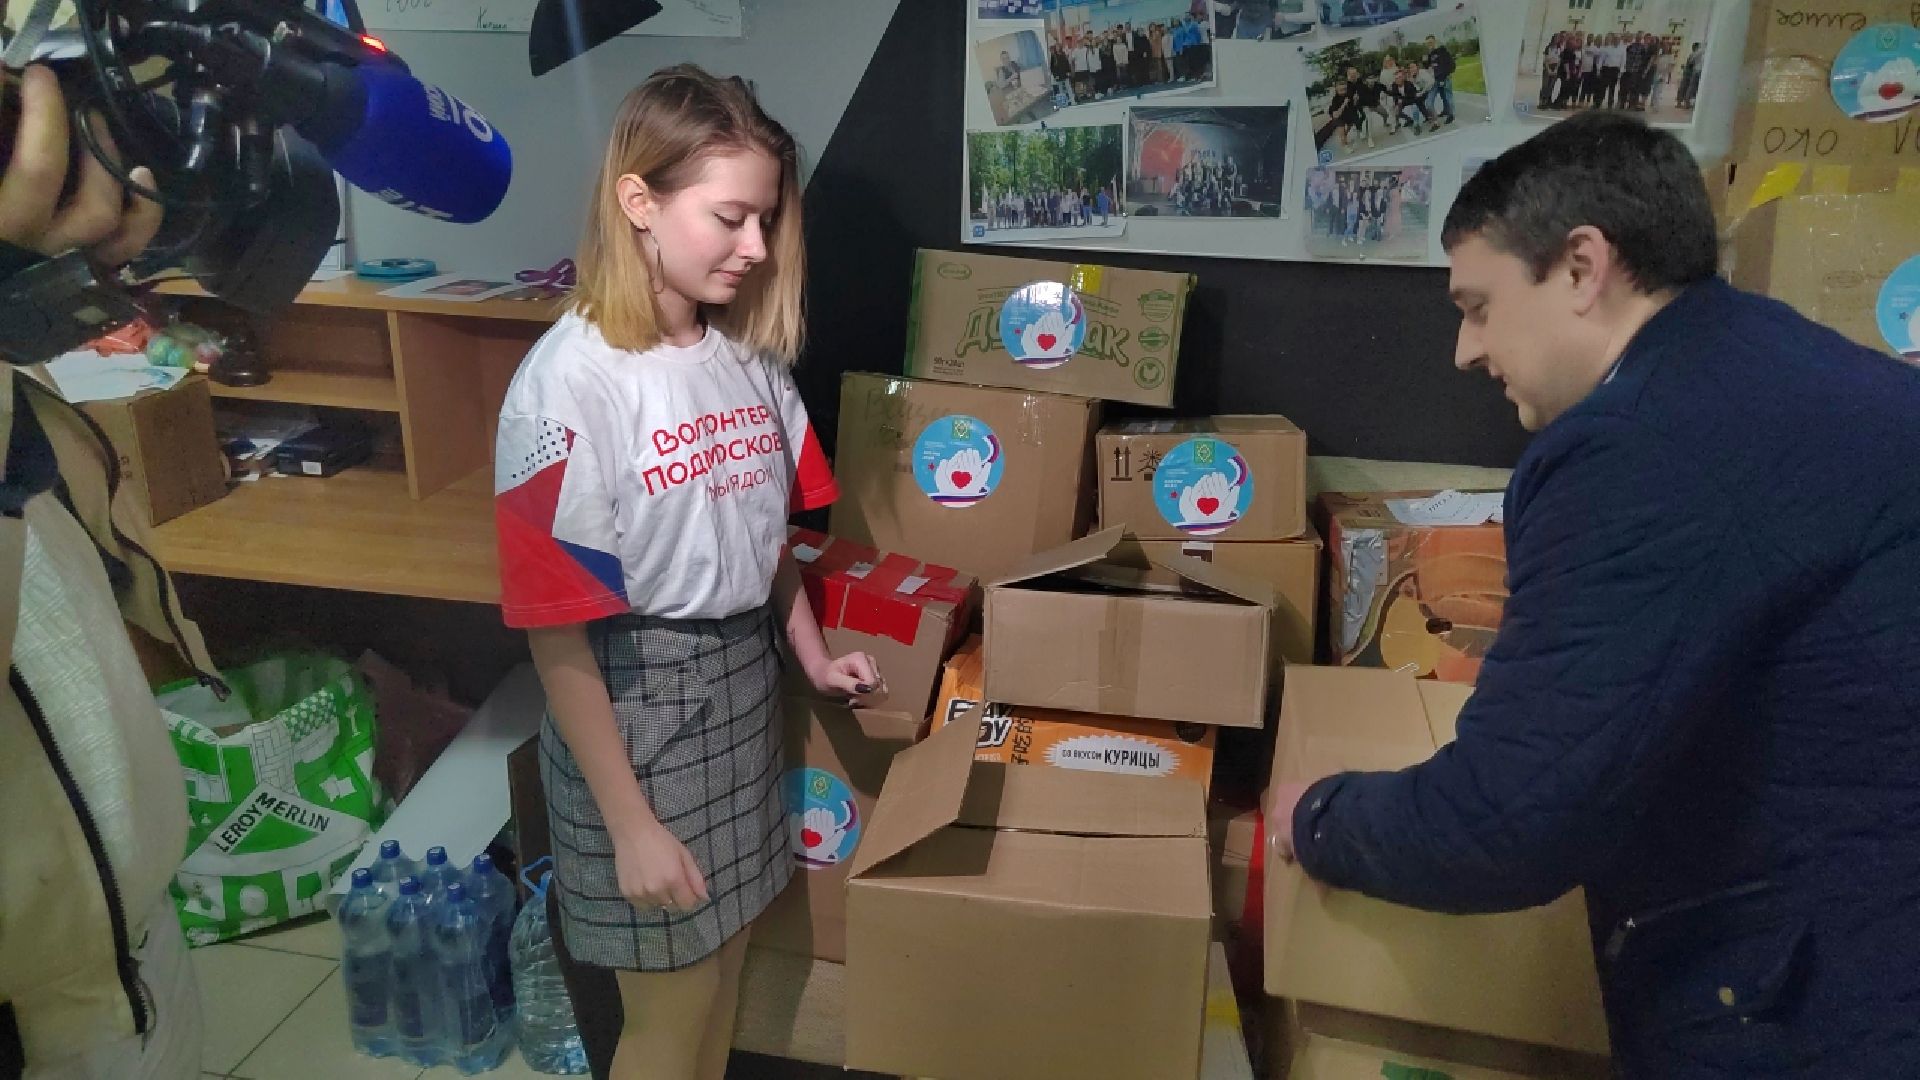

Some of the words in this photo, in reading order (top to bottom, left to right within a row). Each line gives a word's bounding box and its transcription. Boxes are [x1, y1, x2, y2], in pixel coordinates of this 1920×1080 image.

[1104, 748, 1160, 769] КУРИЦЫ
[214, 807, 261, 853] LEROY
[255, 791, 331, 832] MERLIN
